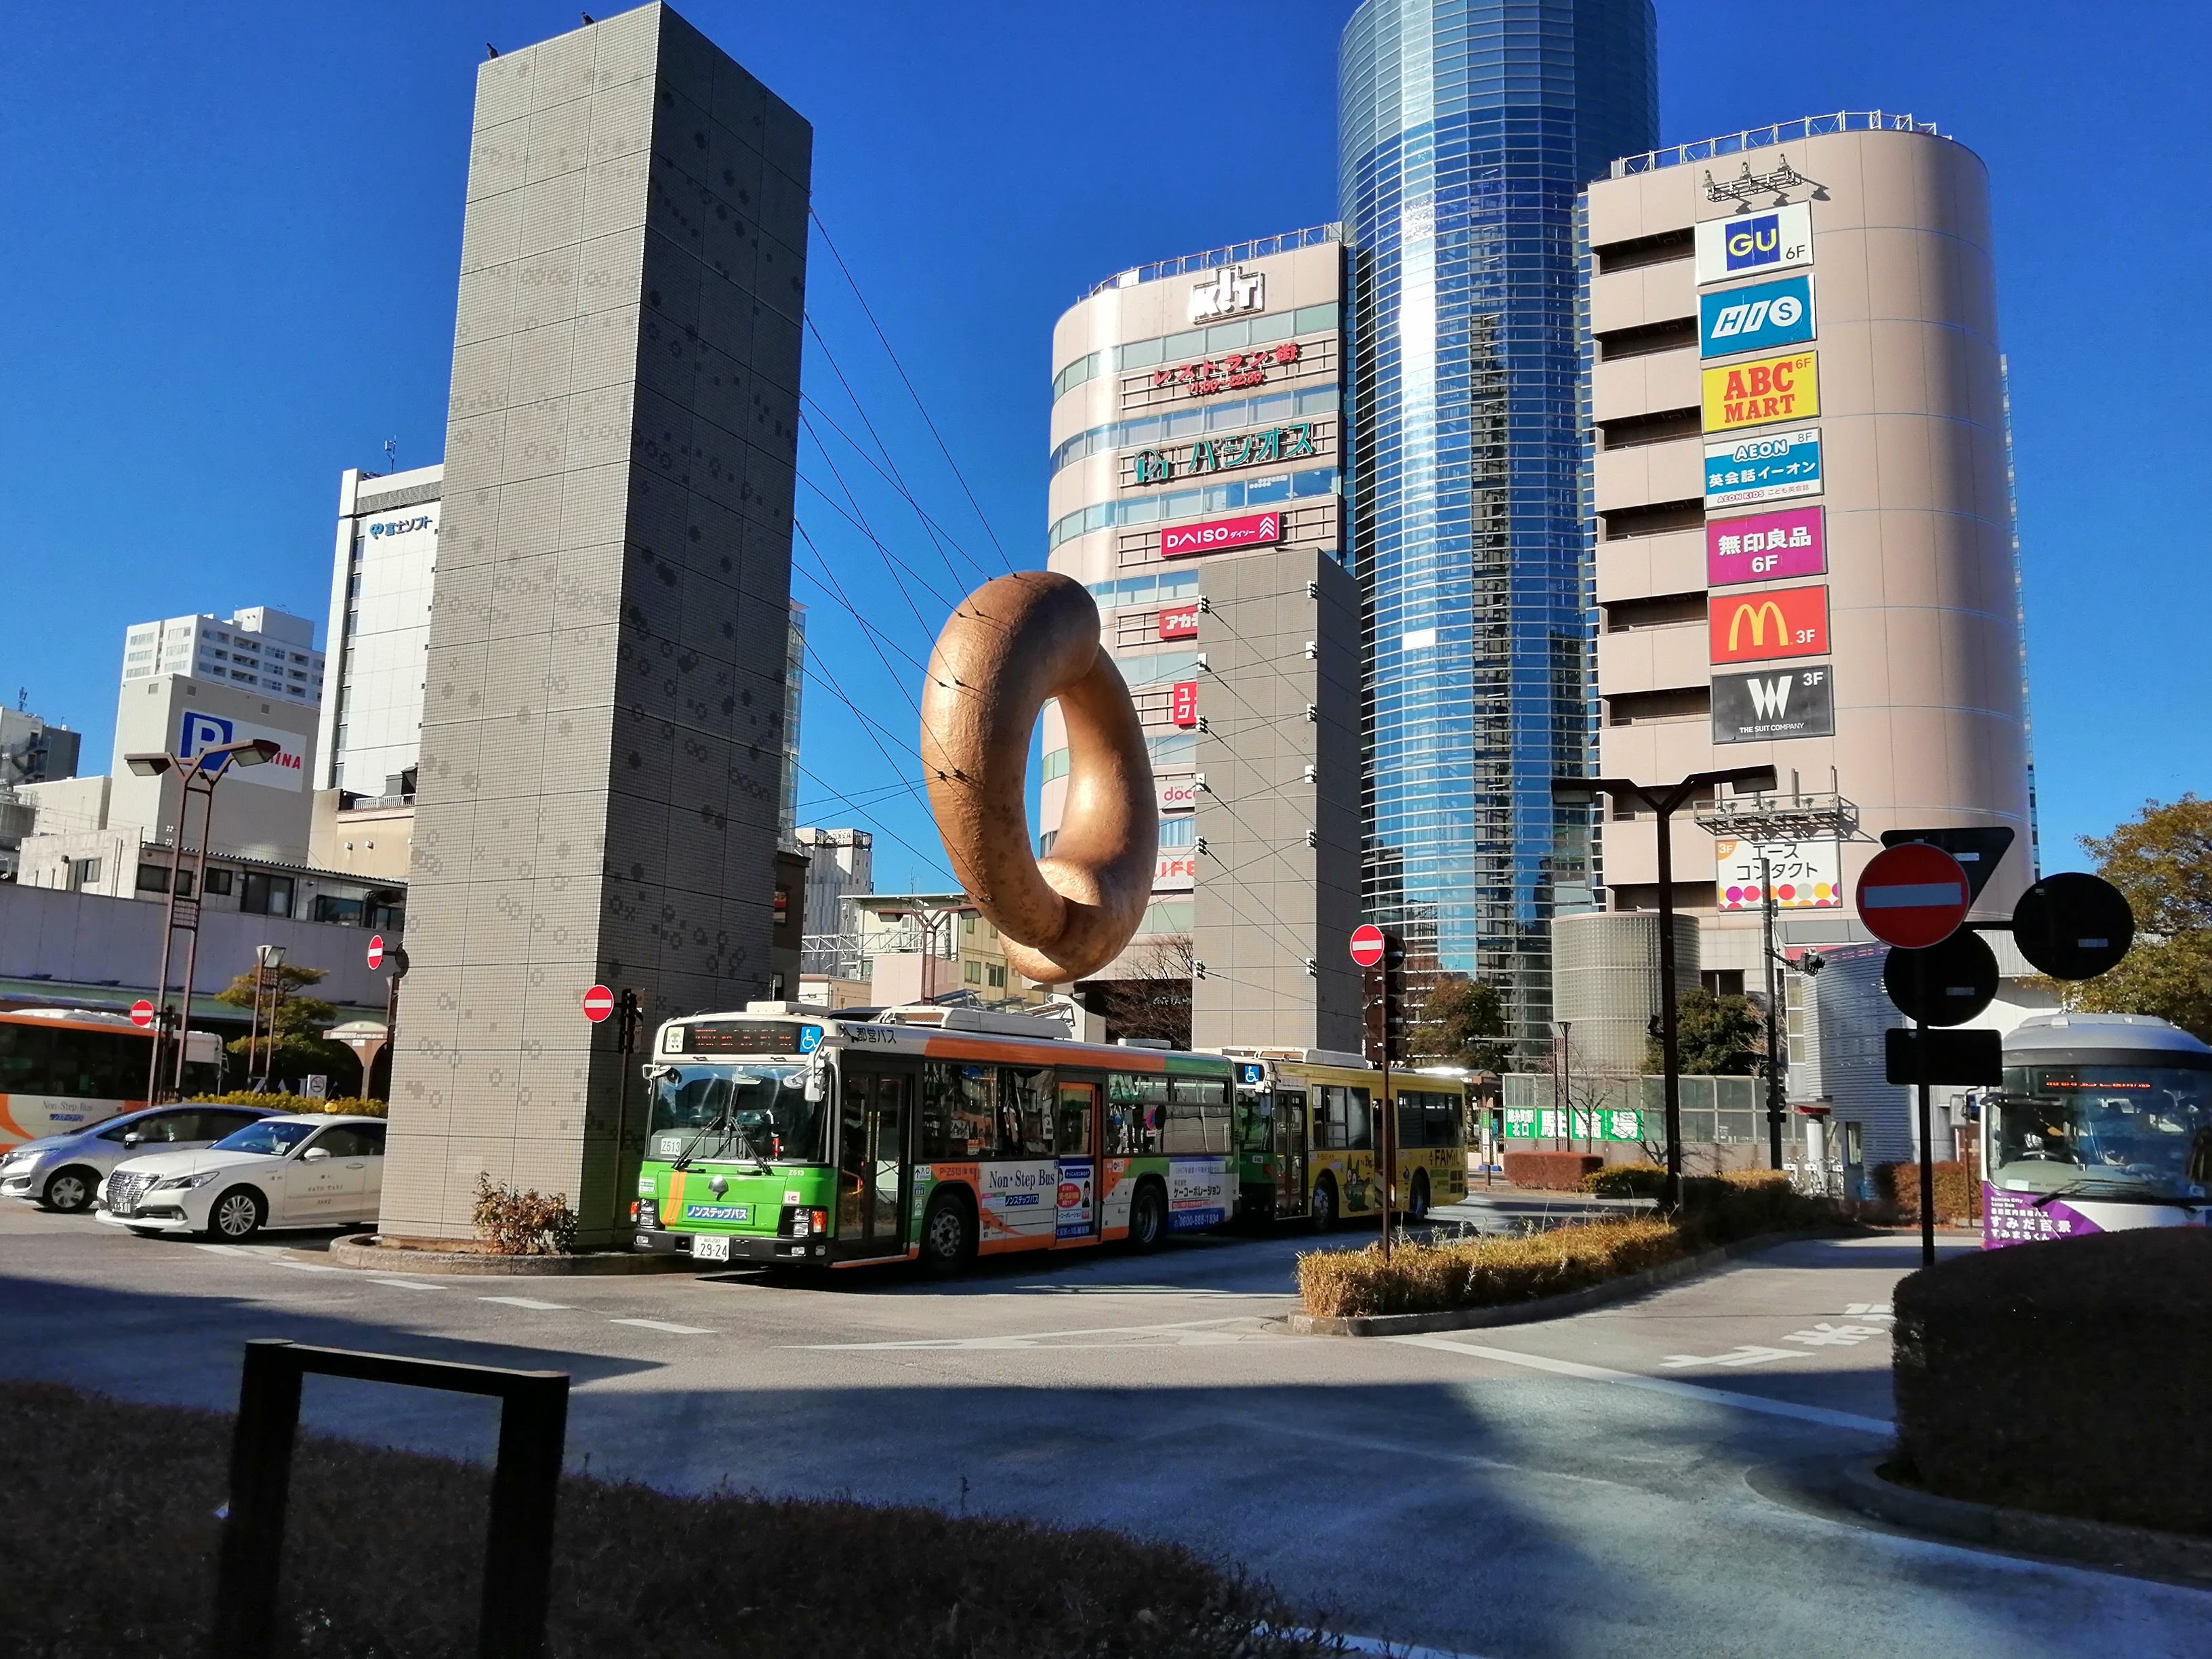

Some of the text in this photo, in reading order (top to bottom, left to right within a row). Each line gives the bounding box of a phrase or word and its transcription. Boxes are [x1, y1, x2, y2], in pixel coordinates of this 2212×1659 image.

[1729, 228, 1776, 256] GU
[1786, 245, 1805, 260] 6F
[1711, 296, 1802, 339] HIS
[1154, 342, 1297, 385] レストラン街
[1795, 357, 1811, 369] 6F
[1724, 361, 1795, 401] ABC
[1724, 394, 1795, 424] MART
[1798, 432, 1813, 443] 8F
[1187, 423, 1313, 473] パシオス
[1735, 439, 1788, 461] AEON
[1708, 462, 1816, 488] 英会話イーオン
[1717, 483, 1809, 504] AEON KIDS こども英会話
[385, 516, 433, 536] 富士ソフト
[1167, 528, 1255, 548] DAISO ダイソー
[1718, 526, 1811, 556] 無印良品
[1752, 554, 1778, 573] 6F
[1796, 628, 1816, 644] 3F
[1803, 672, 1823, 686] 3F
[1746, 675, 1793, 721] W
[1770, 722, 1805, 731] COMPANY
[190, 717, 224, 760] P
[1719, 843, 1733, 854] 3F
[1752, 844, 1799, 861] エース
[1154, 861, 1194, 877] IFE
[857, 1026, 897, 1044] 都営バス
[1507, 1109, 1534, 1124] 錦糸町駅
[1540, 1110, 1639, 1139] 駐輪場
[1513, 1123, 1530, 1136] 北口
[662, 1141, 680, 1152] Z513
[1039, 1168, 1055, 1186] Bus
[1006, 1195, 1039, 1206] ノンステップバス
[1174, 1185, 1221, 1198] ケーコーポレーション
[688, 1206, 747, 1219] ノンステップバス
[1990, 1216, 2071, 1233] すみだ百景
